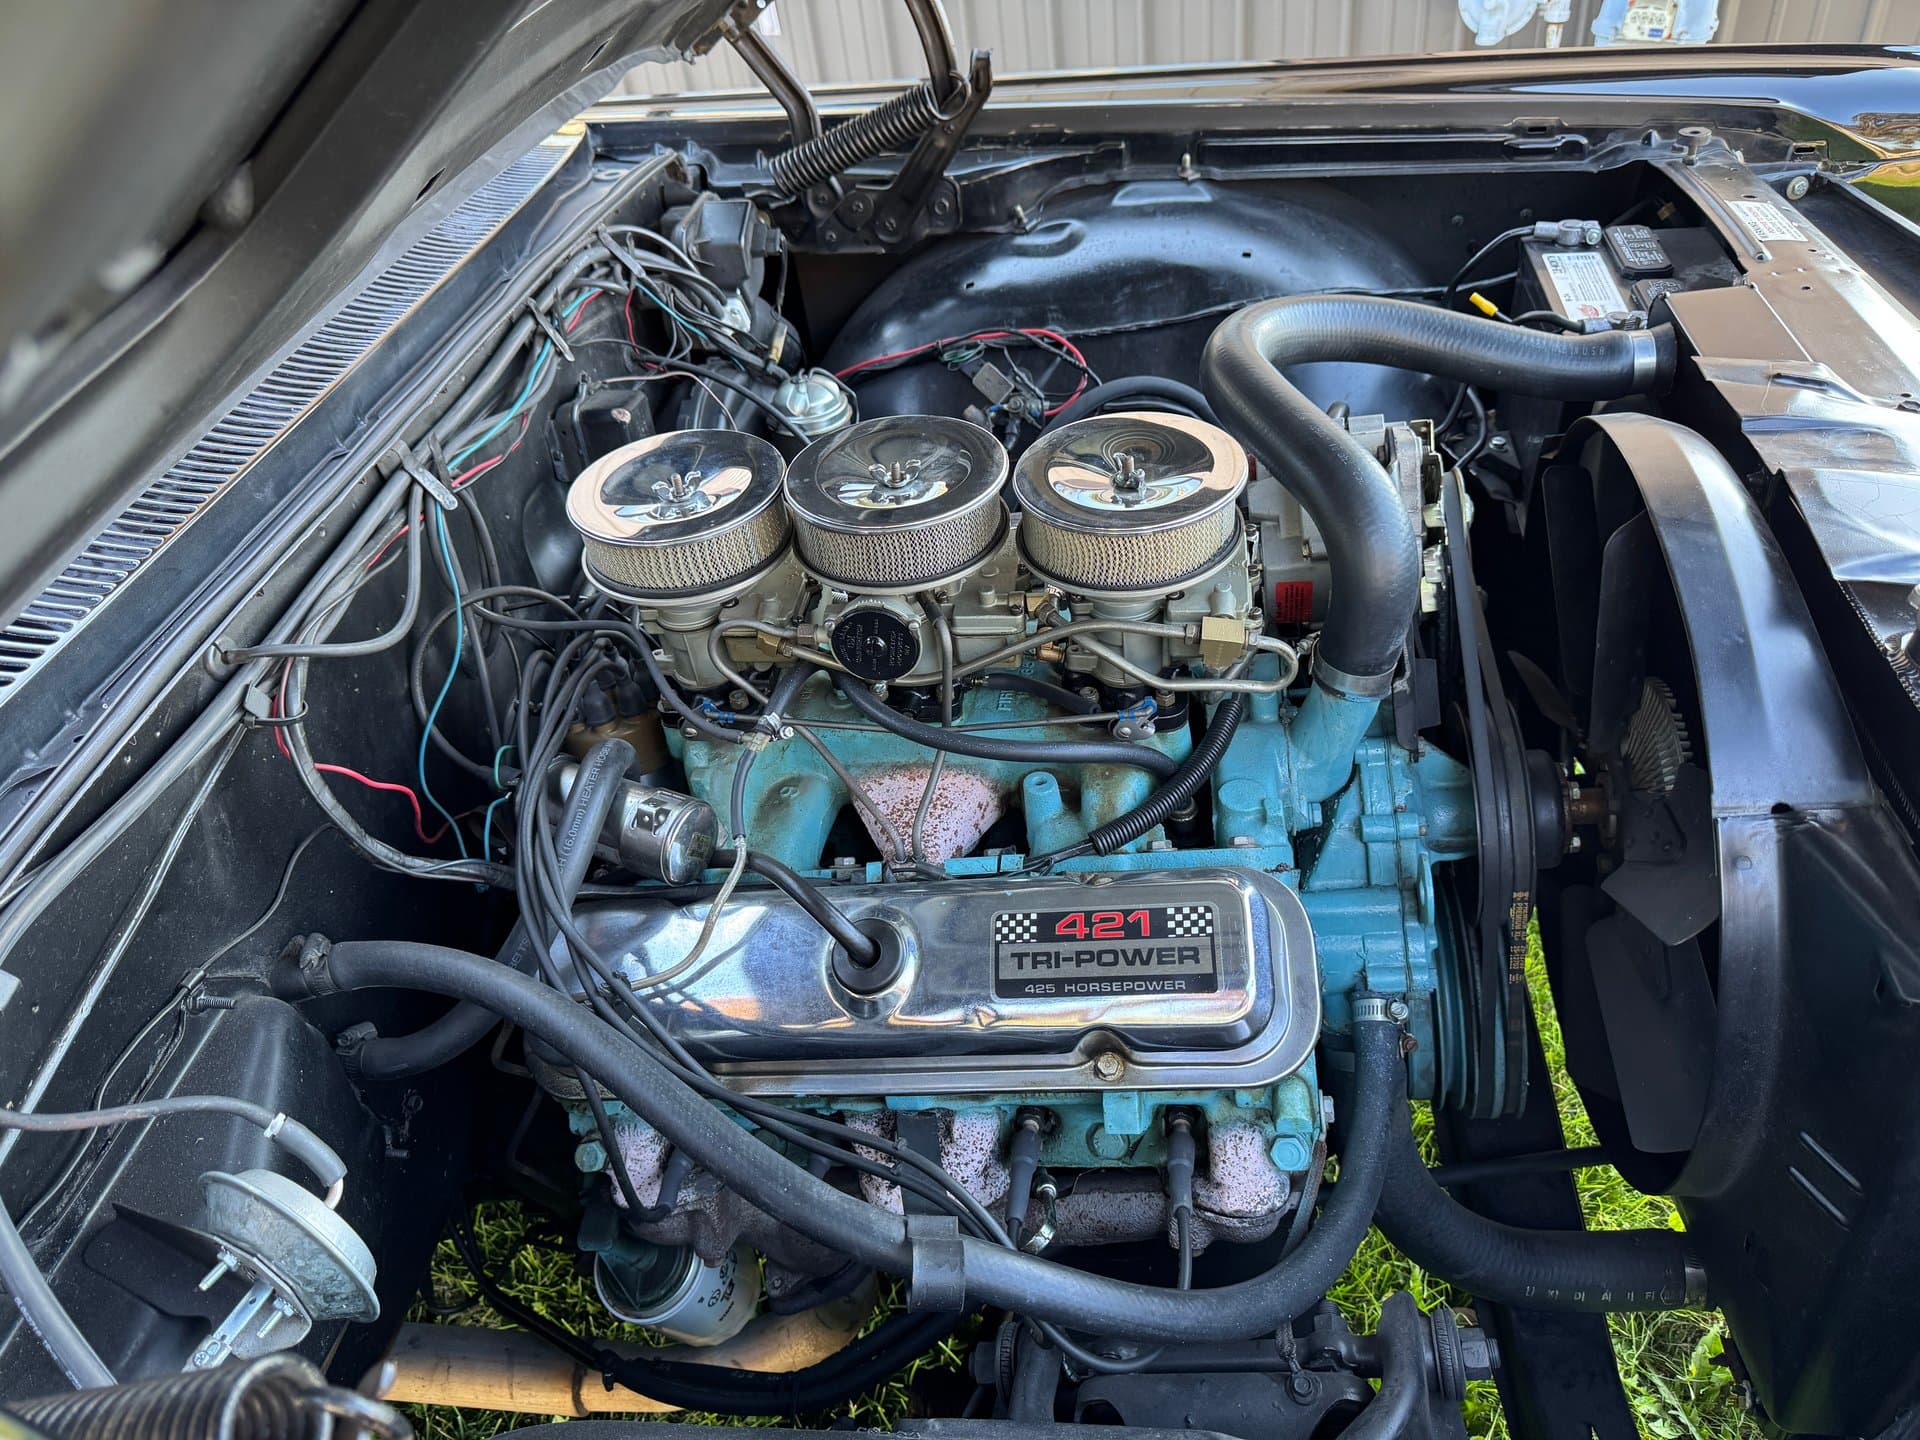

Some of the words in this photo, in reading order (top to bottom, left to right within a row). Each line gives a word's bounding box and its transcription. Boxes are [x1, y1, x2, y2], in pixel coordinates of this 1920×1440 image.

[562, 808, 585, 855] (16.0mm)
[580, 767, 600, 807] HEATER
[594, 743, 611, 767] HOSE
[1055, 910, 1150, 939] 421
[1010, 946, 1200, 970] TRI-POWER
[1024, 984, 1056, 994] 425
[1064, 980, 1186, 993] HORSEPOWER
